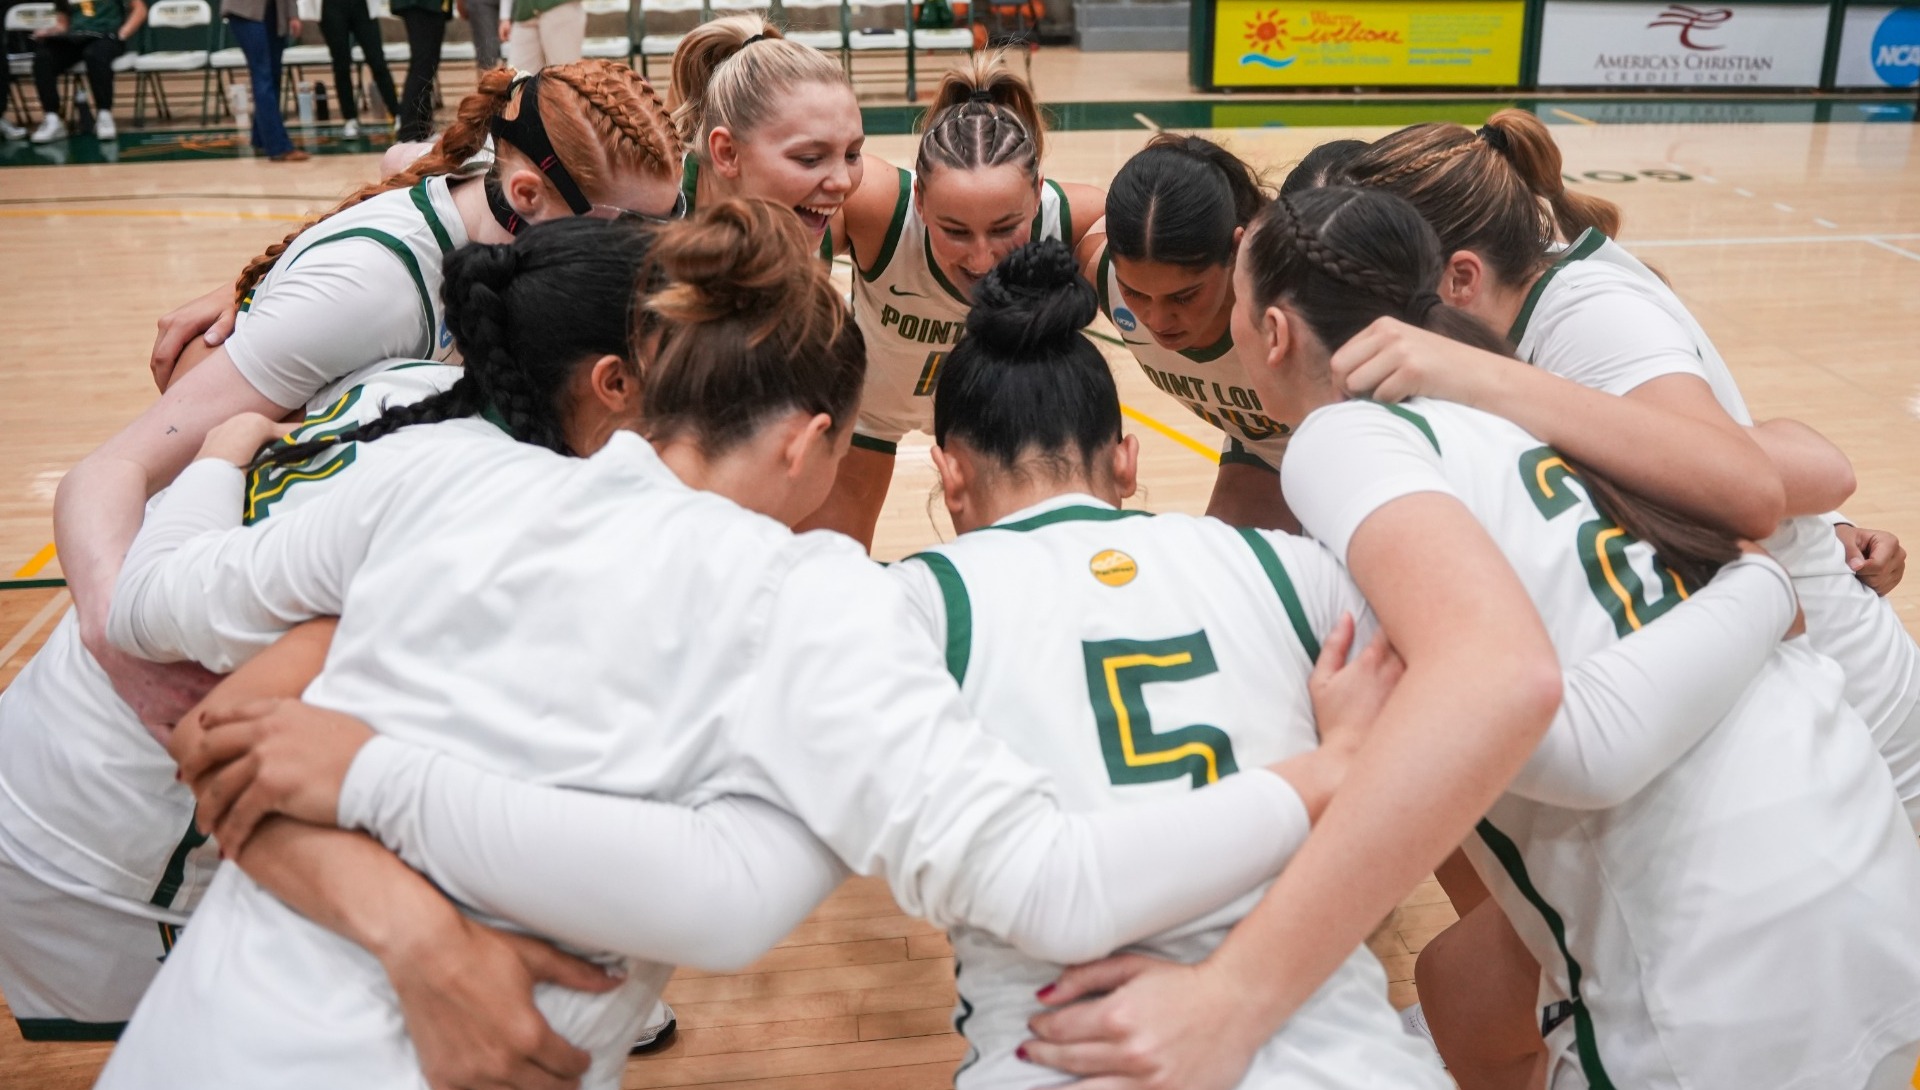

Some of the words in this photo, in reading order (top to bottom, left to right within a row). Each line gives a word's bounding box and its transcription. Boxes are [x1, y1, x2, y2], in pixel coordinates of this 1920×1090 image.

[1684, 54, 1774, 71] CHRISTIAN
[1605, 72, 1680, 83] CREDIT
[1694, 72, 1759, 83] UNION
[1081, 628, 1240, 790] 5
